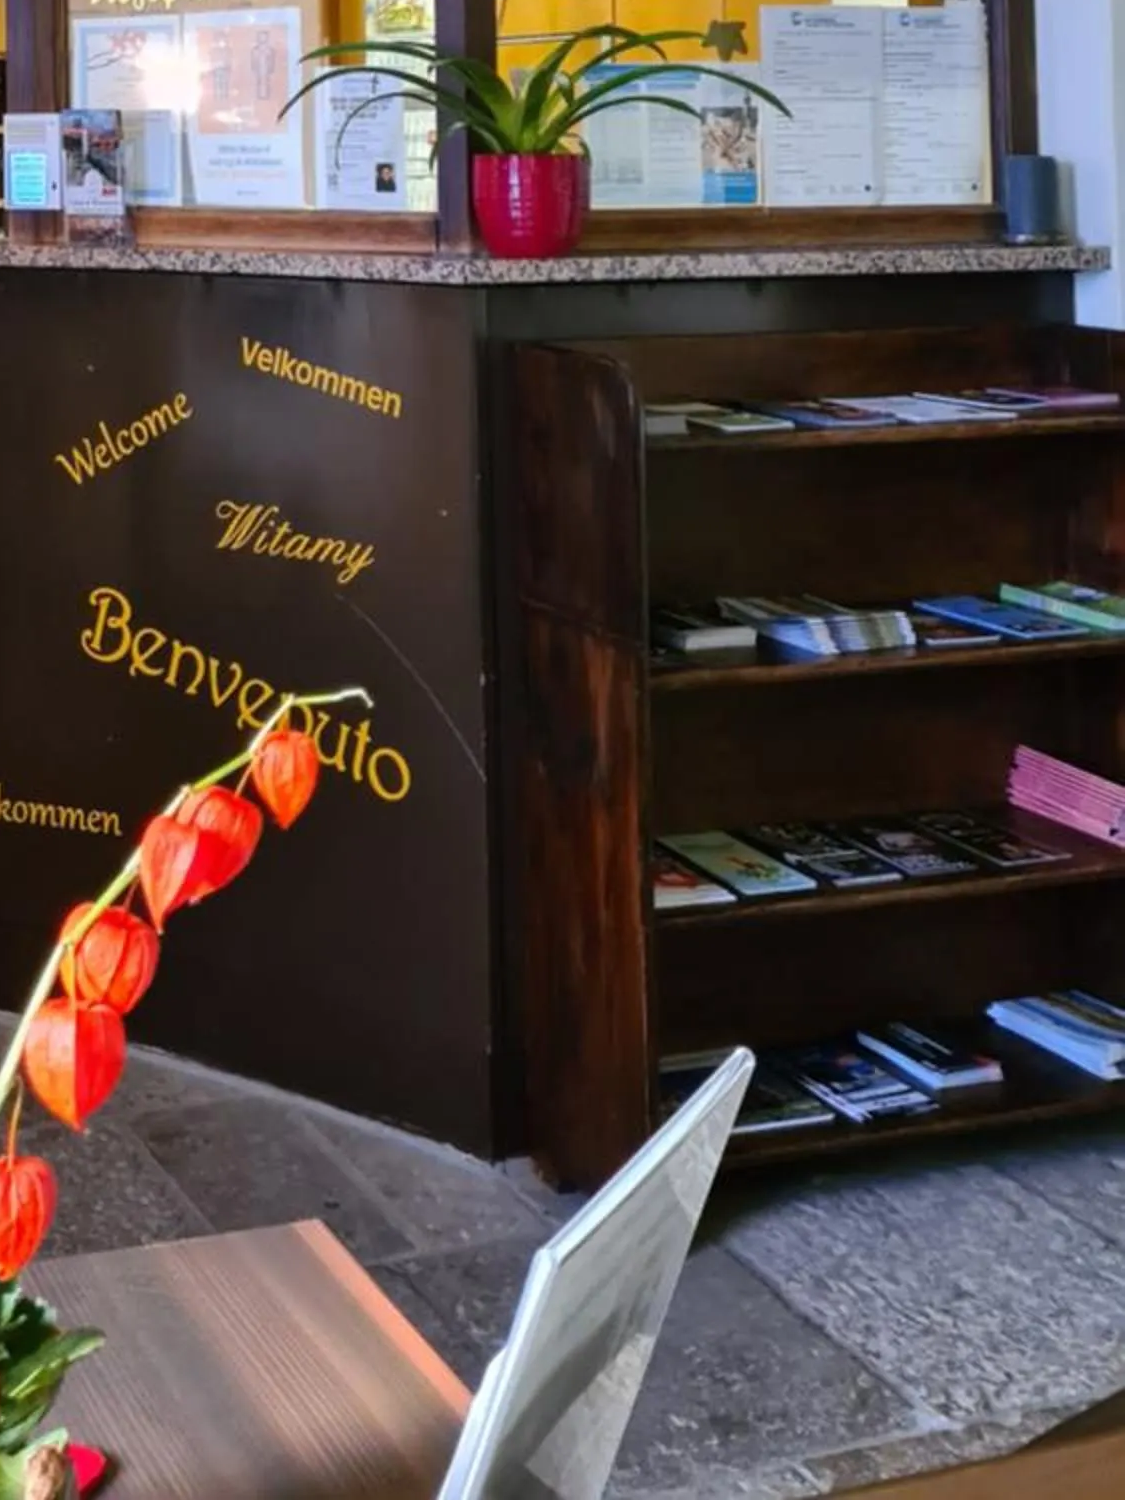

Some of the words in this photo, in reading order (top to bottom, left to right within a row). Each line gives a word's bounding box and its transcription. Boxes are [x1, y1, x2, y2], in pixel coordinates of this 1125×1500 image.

[240, 337, 403, 418] Velkommen
[53, 391, 195, 486] Welcome
[215, 500, 377, 585] Witamy
